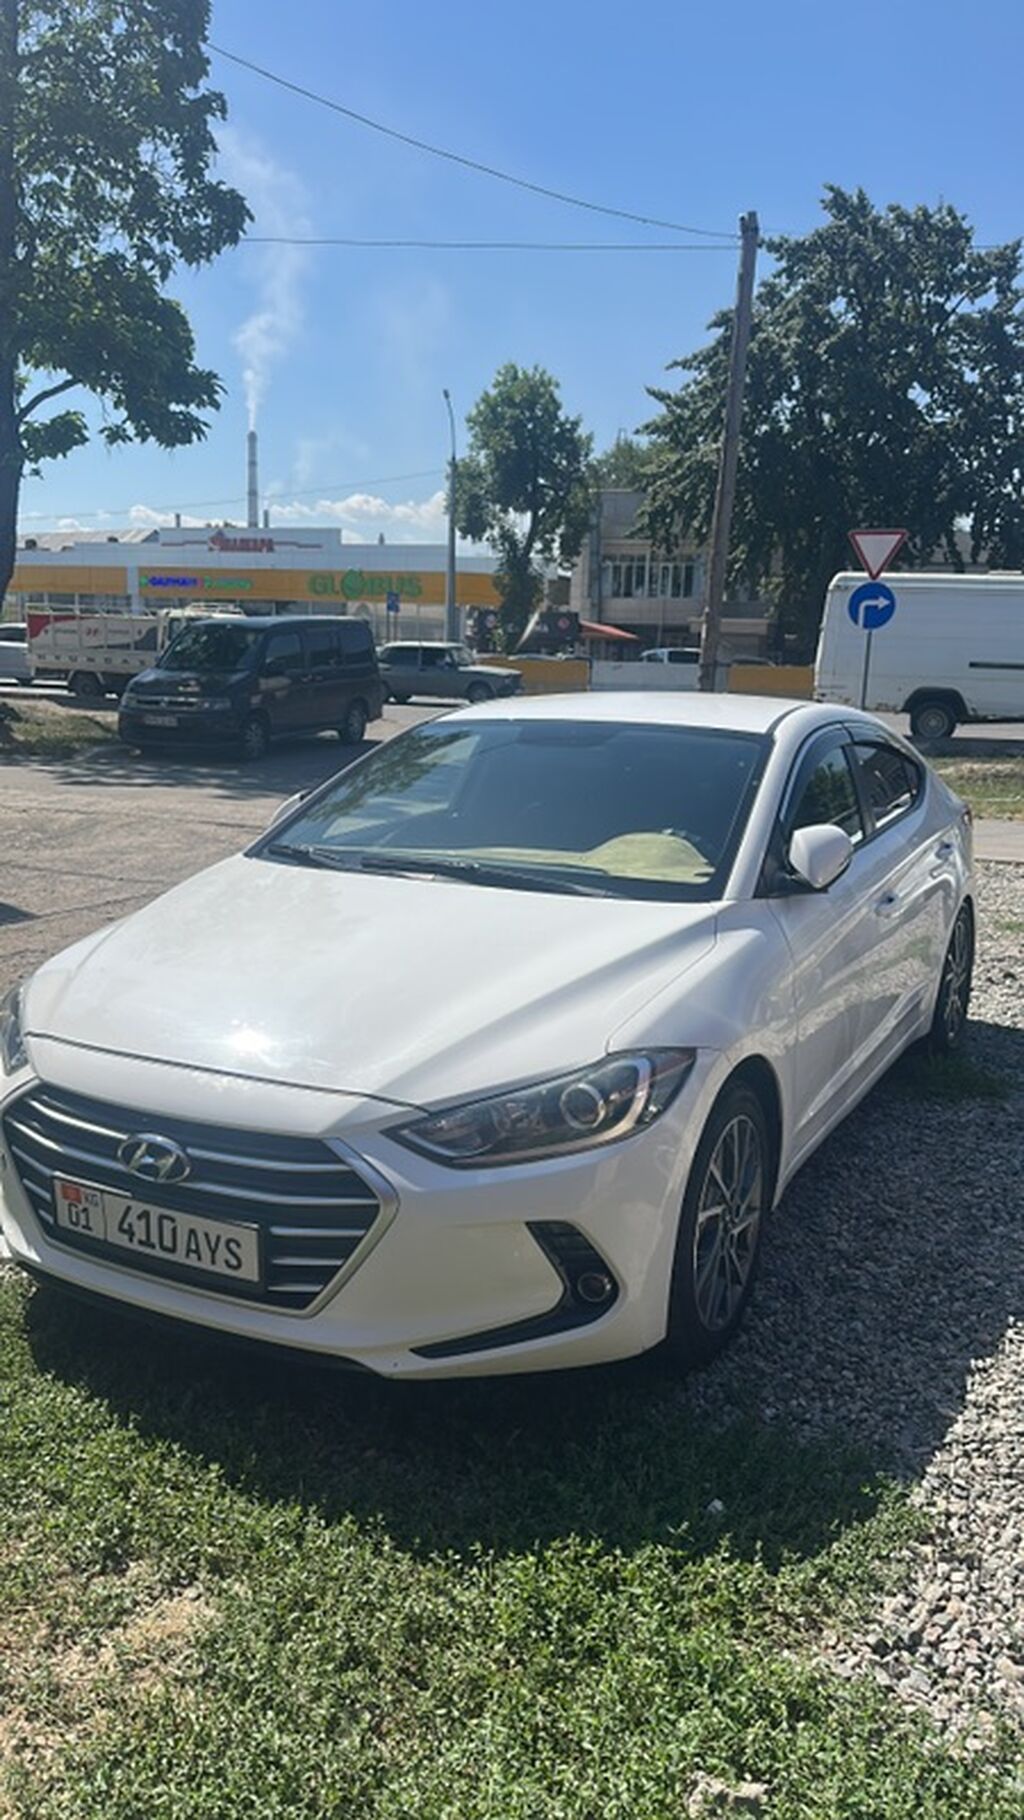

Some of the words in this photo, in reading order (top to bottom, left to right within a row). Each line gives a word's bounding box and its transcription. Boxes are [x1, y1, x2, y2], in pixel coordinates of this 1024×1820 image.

[308, 568, 422, 599] GLOBUS
[67, 1203, 92, 1231] 01
[117, 1204, 178, 1253] 410
[185, 1228, 242, 1270] AYS
